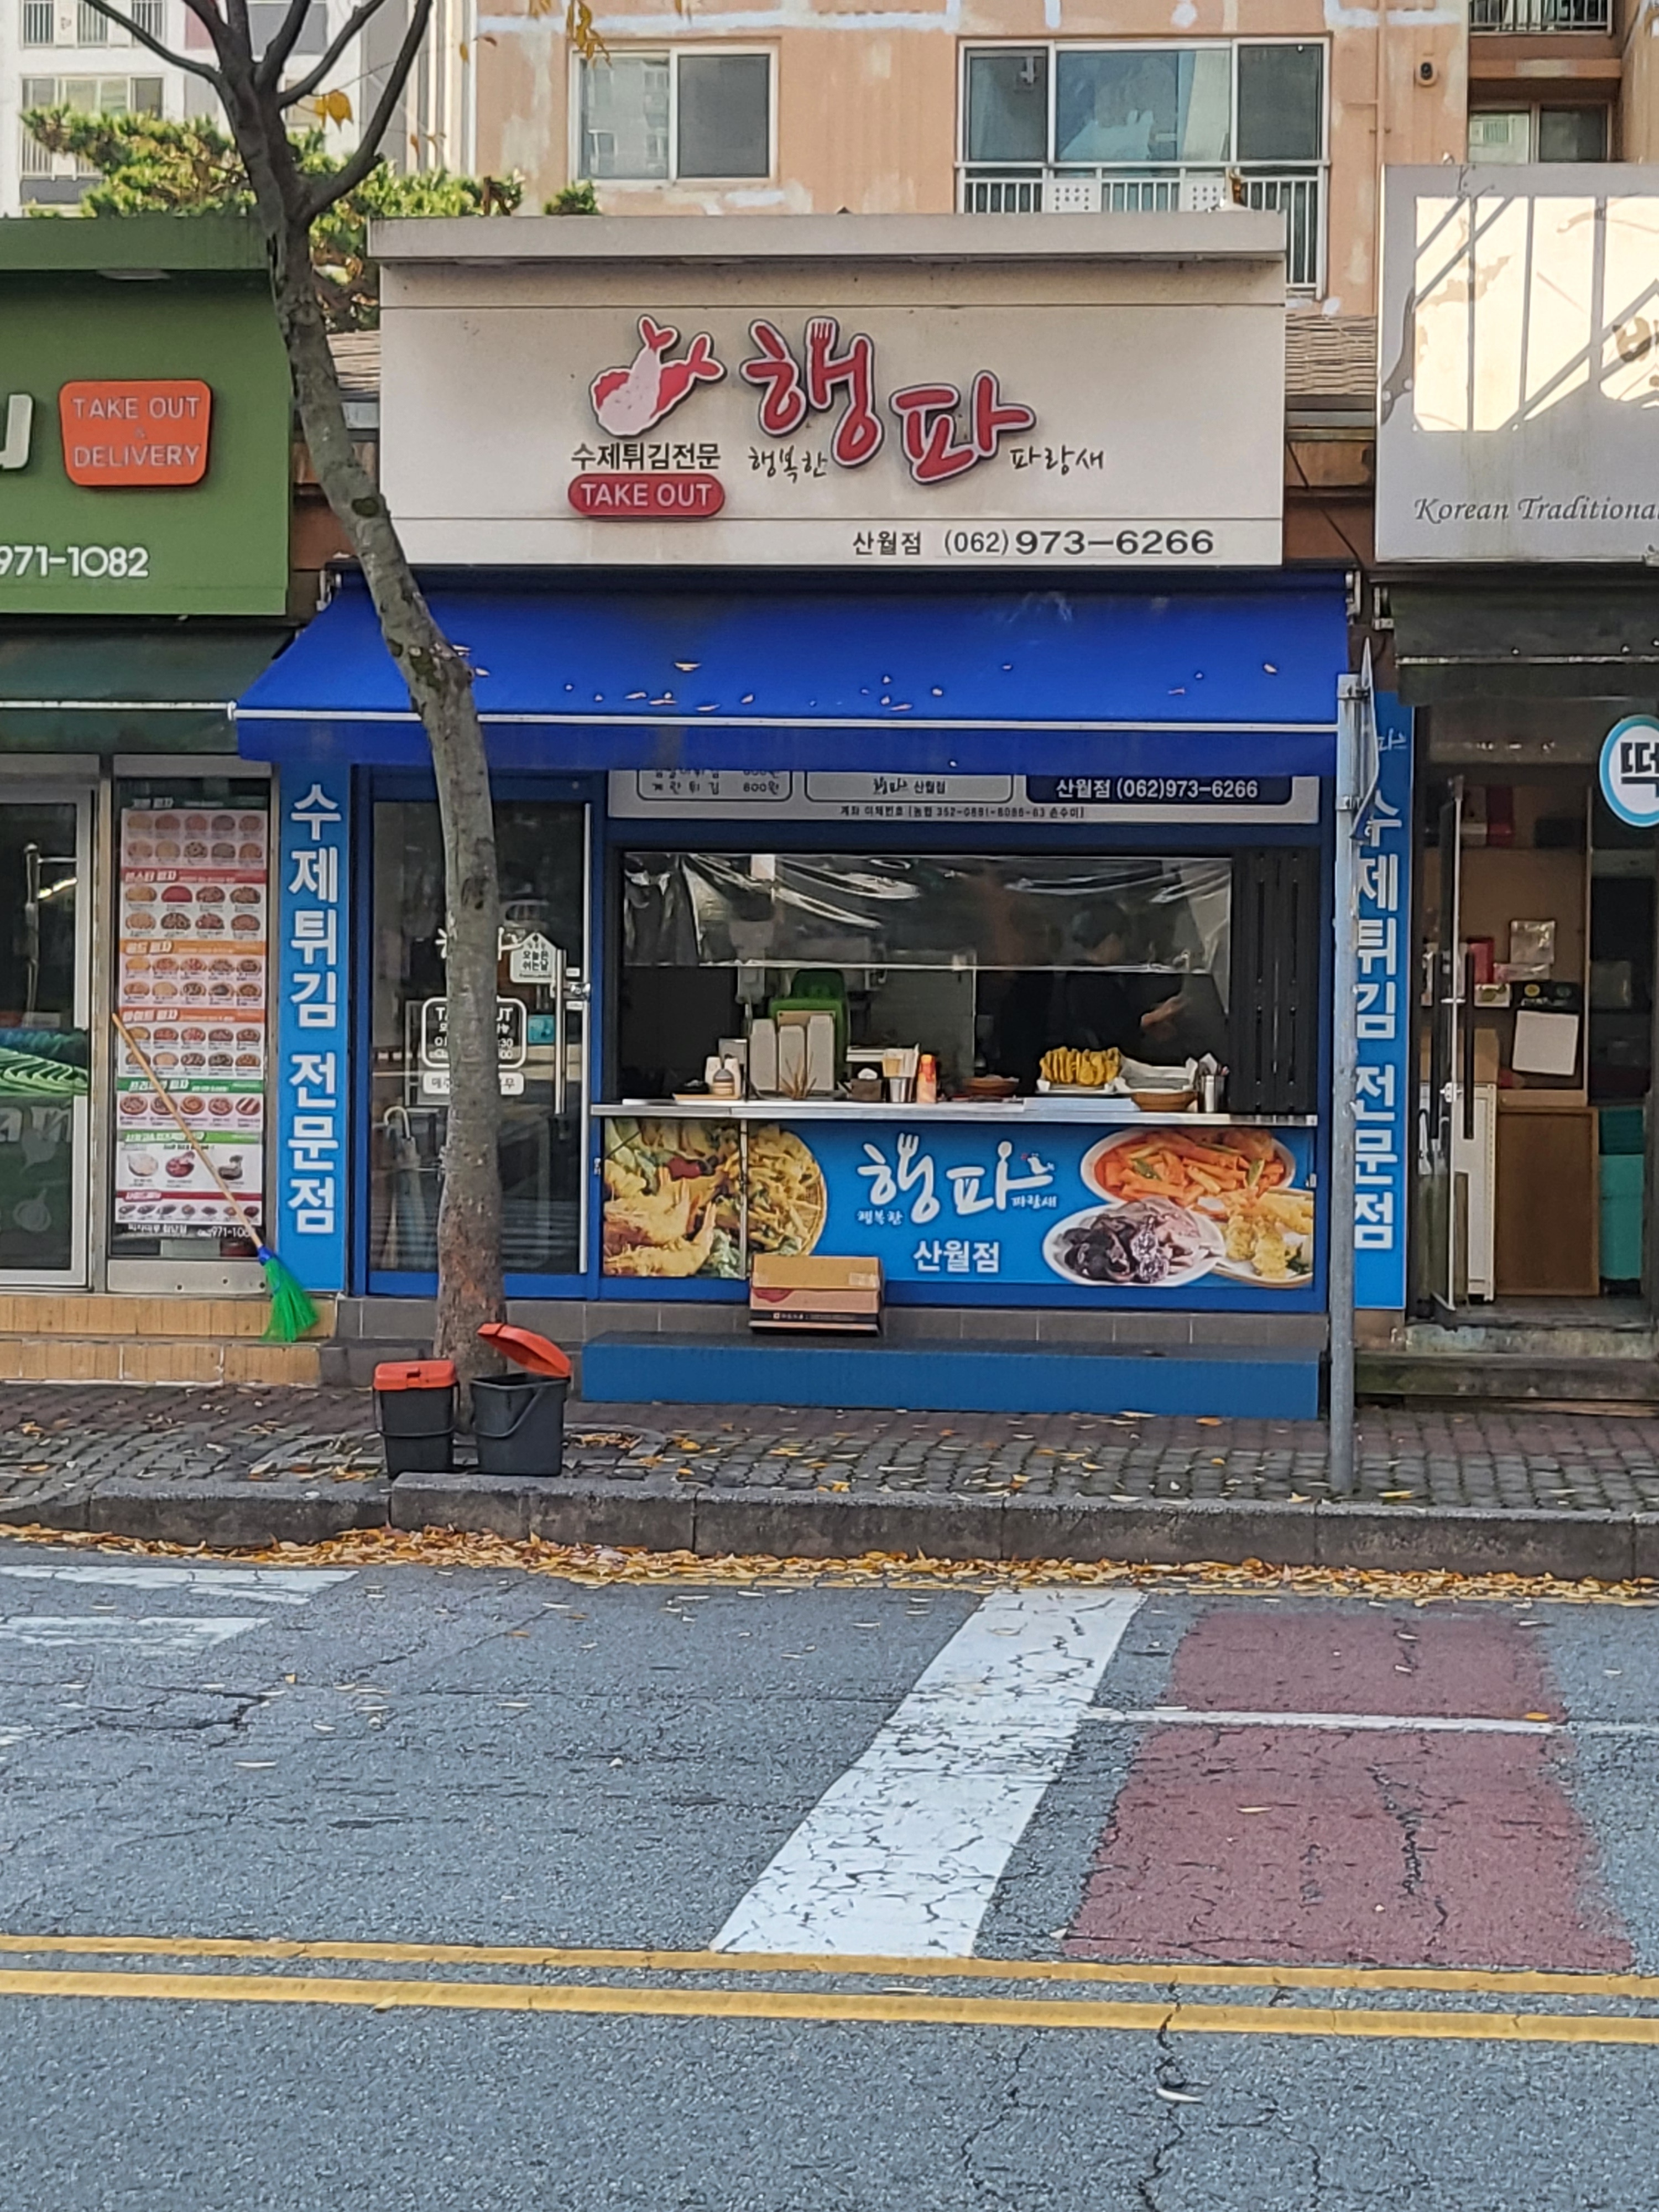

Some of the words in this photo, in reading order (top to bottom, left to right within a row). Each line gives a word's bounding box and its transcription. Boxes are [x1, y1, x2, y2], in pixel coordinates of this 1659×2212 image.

[71, 397, 138, 419] TAKE
[148, 397, 200, 419] OUT
[73, 445, 200, 468] DELIVERY
[571, 443, 721, 471] 수제튀김전문
[747, 445, 830, 483] 행복한
[1010, 446, 1104, 476] 파랑새
[581, 483, 648, 507] TAKE
[656, 483, 713, 507] OUT
[1413, 497, 1510, 524] Korean
[1517, 494, 1659, 521] Traditiona
[852, 531, 921, 556] 산월점
[1056, 778, 1110, 799] 산월점
[1116, 777, 1259, 800] (062)973-6266
[288, 784, 341, 1027] 수제튀김
[287, 1052, 339, 1233] 전문점
[913, 1240, 1000, 1273] 산월점
